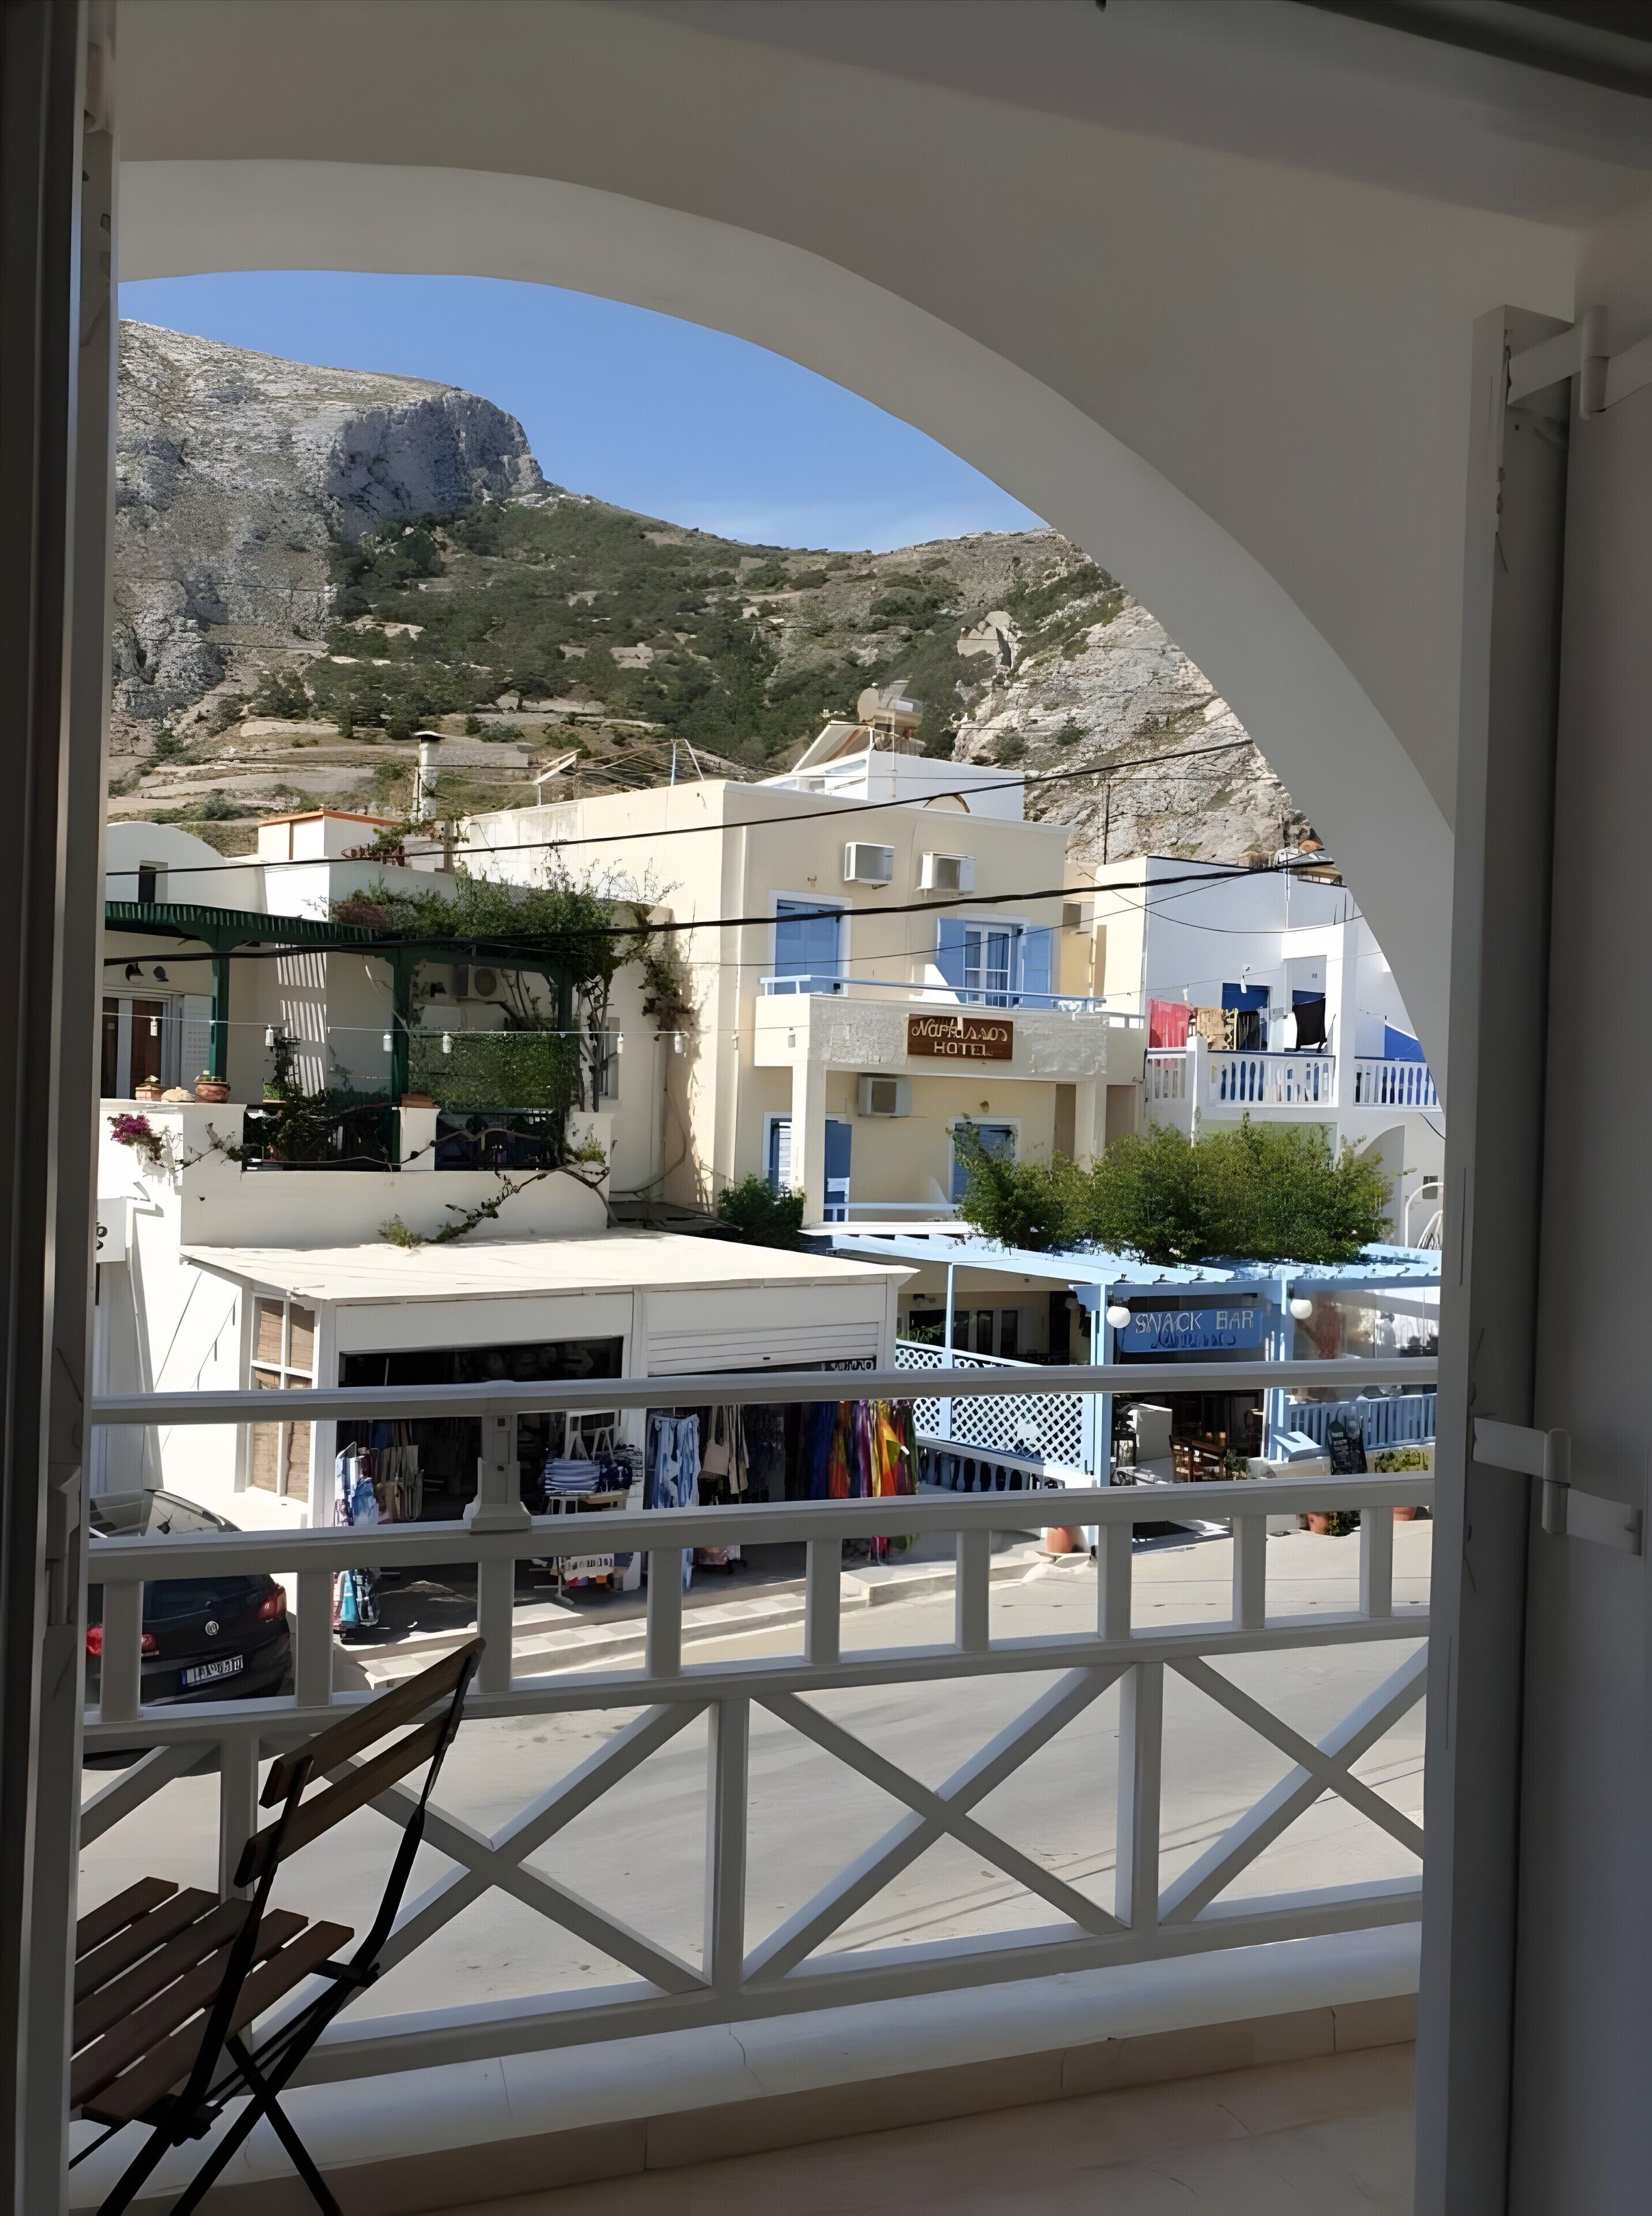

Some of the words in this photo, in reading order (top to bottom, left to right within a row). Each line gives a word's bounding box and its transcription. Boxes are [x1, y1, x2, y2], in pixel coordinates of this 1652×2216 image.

[934, 1041, 992, 1057] HOTEL
[1136, 1312, 1202, 1334] SNACK
[1216, 1311, 1253, 1330] BAR
